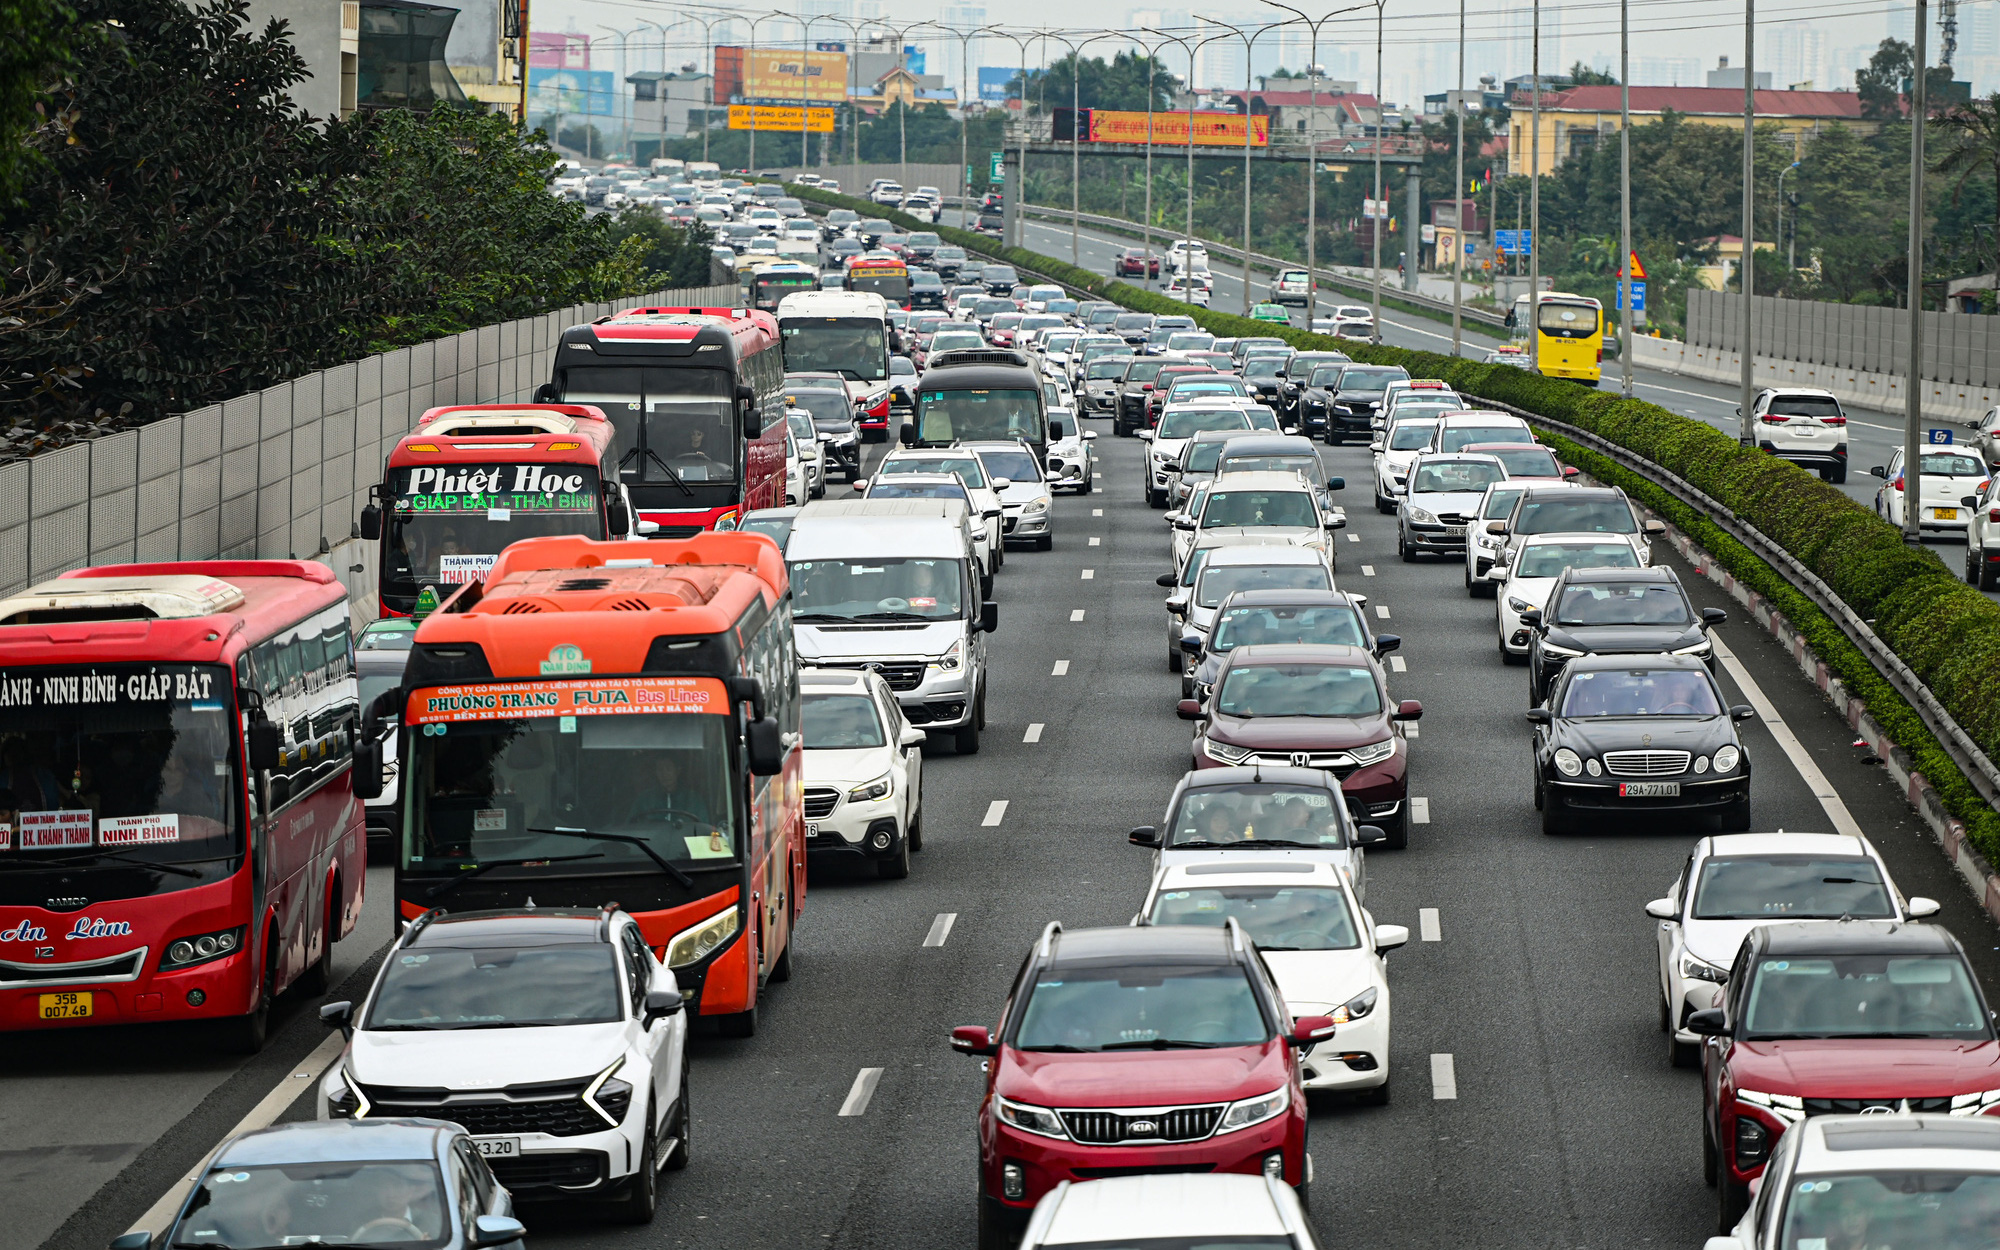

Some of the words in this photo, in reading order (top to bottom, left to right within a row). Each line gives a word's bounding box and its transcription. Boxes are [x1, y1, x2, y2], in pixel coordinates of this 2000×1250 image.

[405, 466, 502, 500] Phiệt
[512, 465, 583, 499] Học
[413, 493, 457, 510] GIÁP
[559, 491, 593, 508] BÌN
[444, 556, 473, 566] THÀNH
[476, 555, 493, 565] PHỐ
[442, 566, 466, 584] THÁI
[543, 663, 563, 672] NAM
[43, 676, 79, 704] NINH
[82, 668, 117, 703] BÌNH
[127, 666, 171, 701] GIÁP
[438, 686, 462, 695] CÔNG
[463, 686, 474, 694] TY
[427, 693, 496, 712] PHƯƠNG
[499, 692, 559, 708] TRANG
[573, 689, 629, 705] FUTA
[636, 688, 665, 703] Bus
[669, 688, 709, 703] Lines
[480, 711, 495, 719] XE
[497, 710, 524, 718] NAM
[526, 709, 555, 718] ĐỊNH
[615, 704, 641, 713] GIÁP
[666, 704, 682, 712] HÀ
[684, 704, 703, 714] NỘI
[1627, 785, 1678, 796] 29A-771.01
[117, 816, 143, 826] THÀNH
[23, 830, 36, 847] BX.
[37, 825, 64, 846] KHÁNH
[65, 823, 90, 845] THÀNH
[102, 828, 138, 843] NINH
[142, 824, 177, 840] BÌNH
[0, 918, 48, 942] An
[65, 916, 133, 940] Lâm
[54, 993, 78, 1005] 35B
[45, 1005, 87, 1018] 007.48
[1133, 1123, 1152, 1132] KIA
